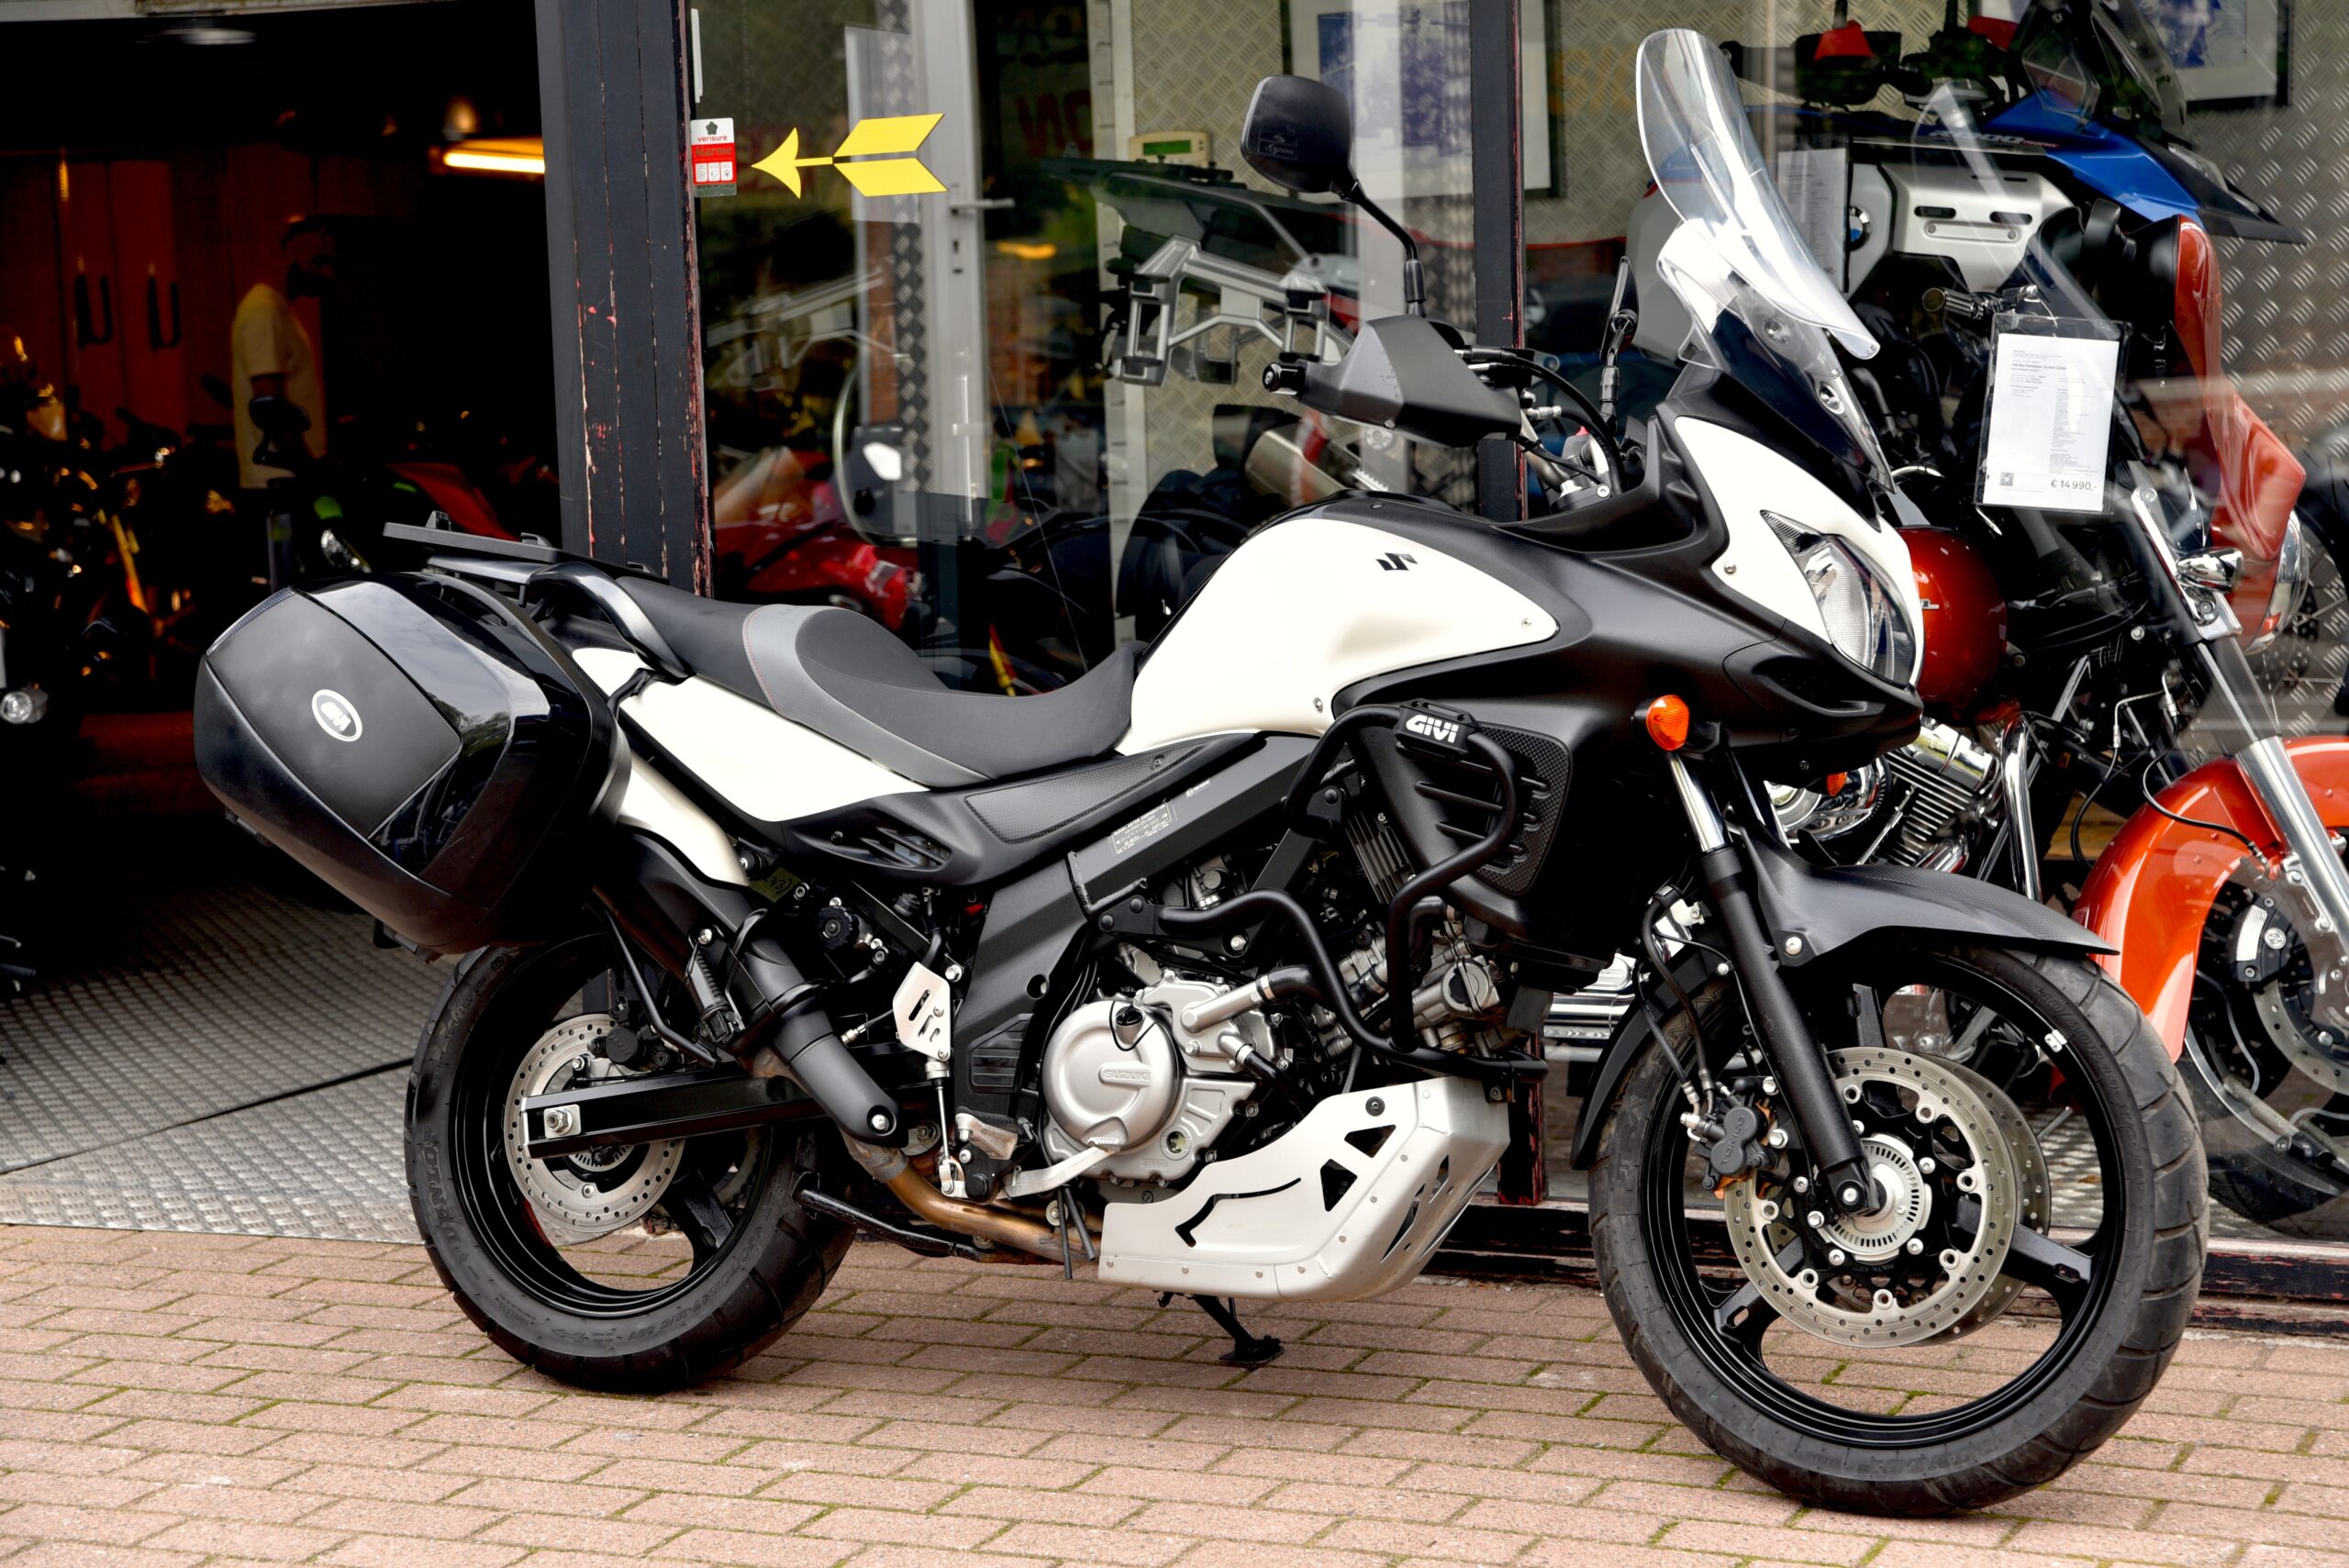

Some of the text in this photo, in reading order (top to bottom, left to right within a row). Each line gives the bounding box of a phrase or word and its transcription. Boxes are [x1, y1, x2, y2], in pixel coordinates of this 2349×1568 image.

[695, 147, 732, 157] Alarme
[2051, 479, 2057, 488] €
[2061, 480, 2070, 488] 14
[1406, 715, 1459, 743] GIVI
[1103, 1069, 1152, 1082] SUZUKI
[1720, 1115, 1745, 1165] TOKICO
